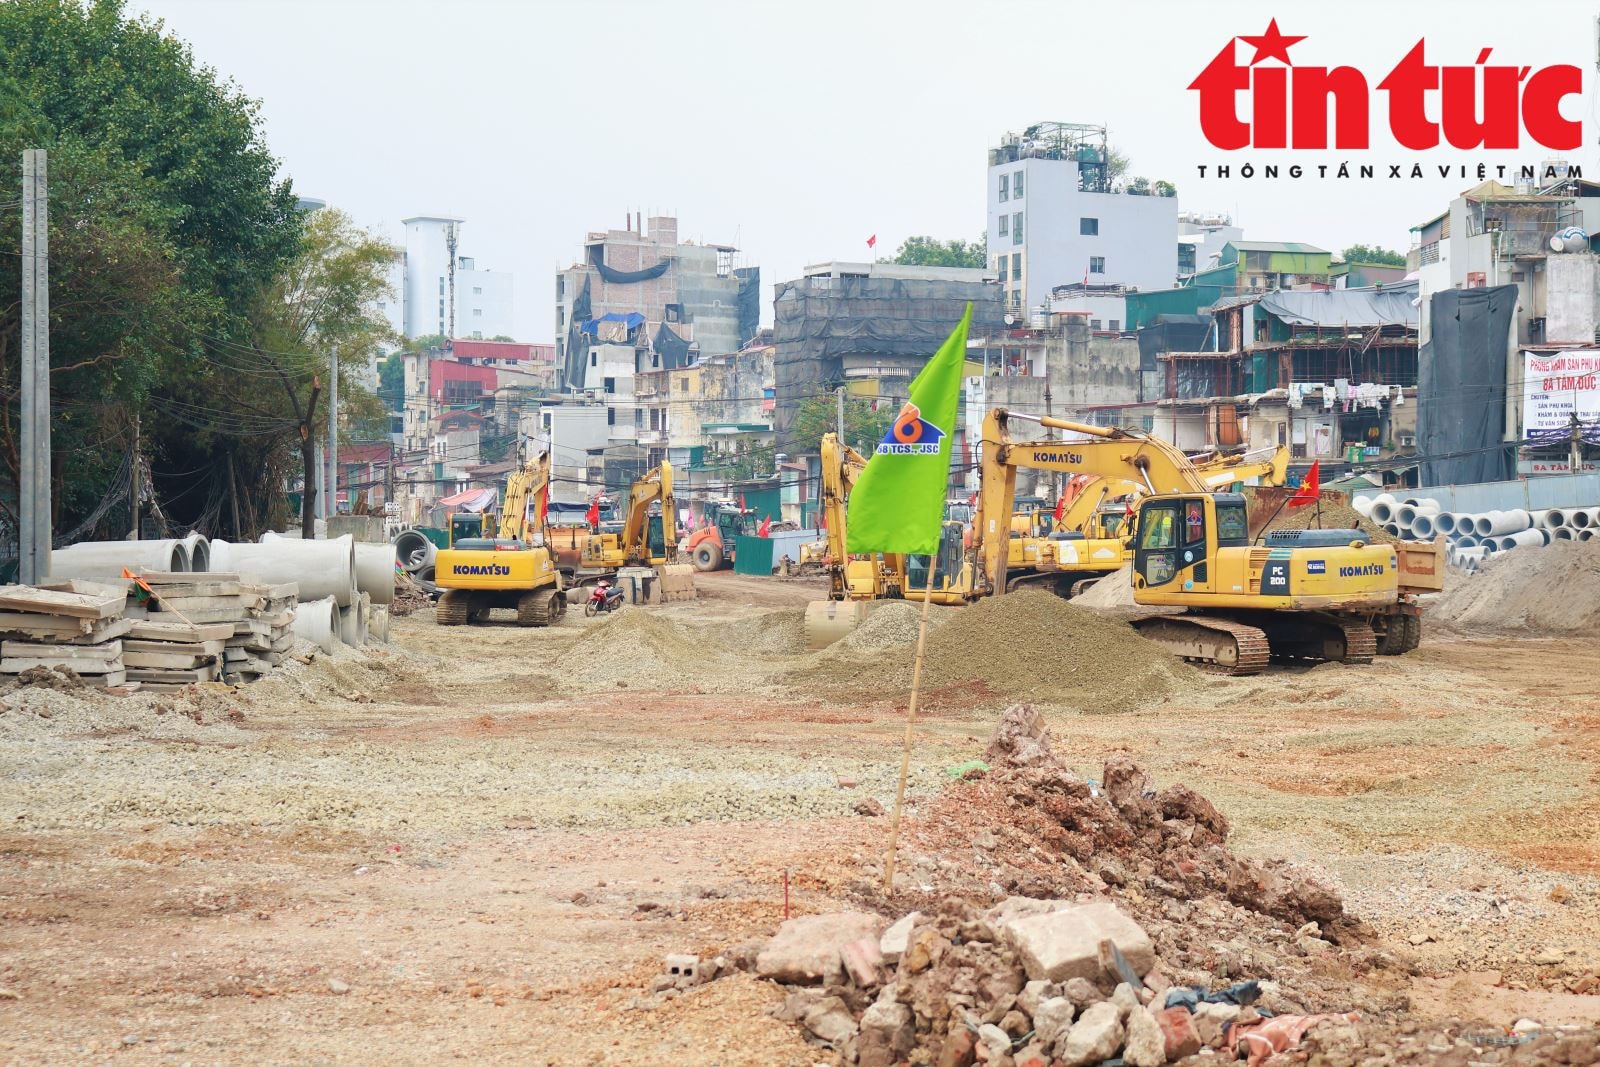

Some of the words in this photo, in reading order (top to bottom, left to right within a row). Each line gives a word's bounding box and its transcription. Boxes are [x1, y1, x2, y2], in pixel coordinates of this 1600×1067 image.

[920, 445, 939, 454] JSC
[1033, 452, 1083, 464] KOMATSU
[453, 563, 510, 575] KOMATSU
[1272, 567, 1283, 575] PC
[1339, 563, 1384, 577] KOMATSU
[1270, 577, 1286, 585] 200
